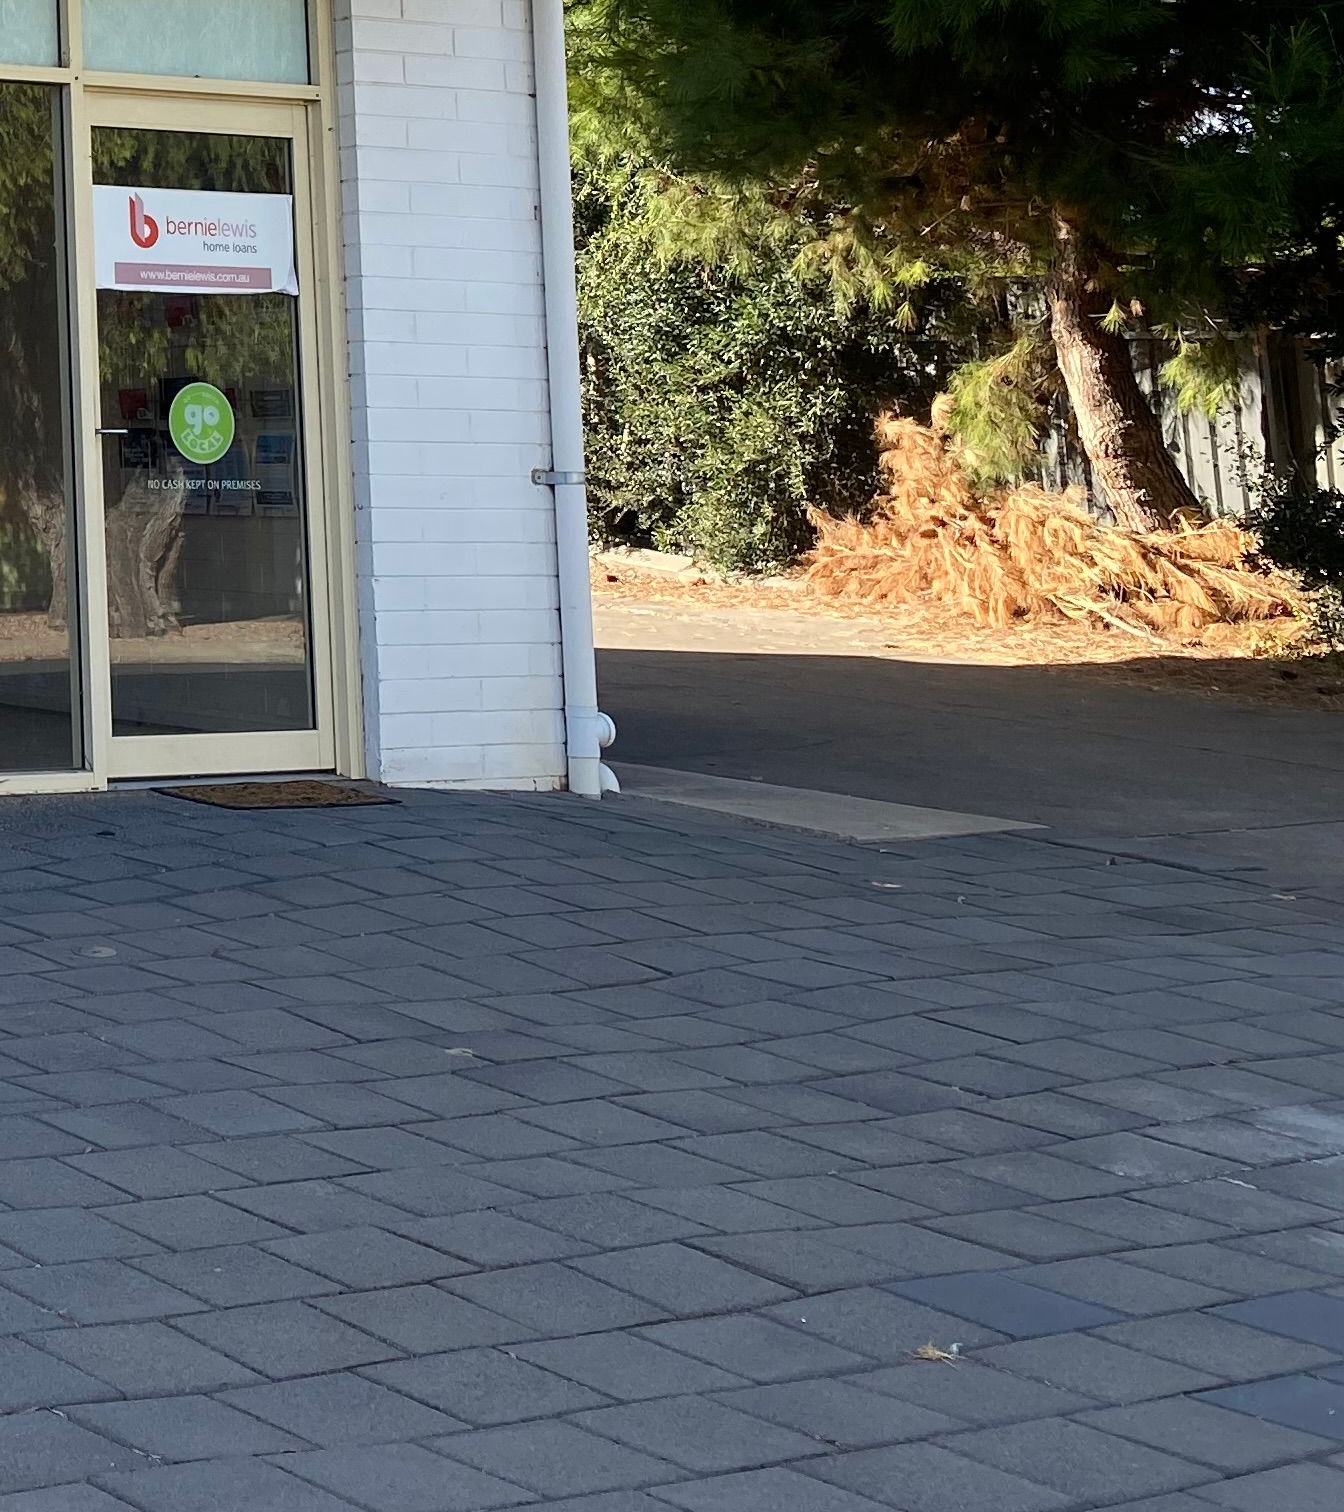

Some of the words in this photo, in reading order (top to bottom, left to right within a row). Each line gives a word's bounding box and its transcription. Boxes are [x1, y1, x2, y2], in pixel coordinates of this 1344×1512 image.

[165, 215, 257, 239] bernielewis
[202, 240, 230, 253] home
[232, 241, 258, 254] loans
[139, 268, 251, 284] www.bernielewis.com.au
[184, 403, 221, 436] go
[182, 431, 222, 453] LOCAL
[147, 479, 160, 489] NO
[161, 479, 185, 490] CASH
[185, 479, 206, 489] KEPT
[207, 479, 220, 490] ON
[221, 479, 262, 490] PREMISES
